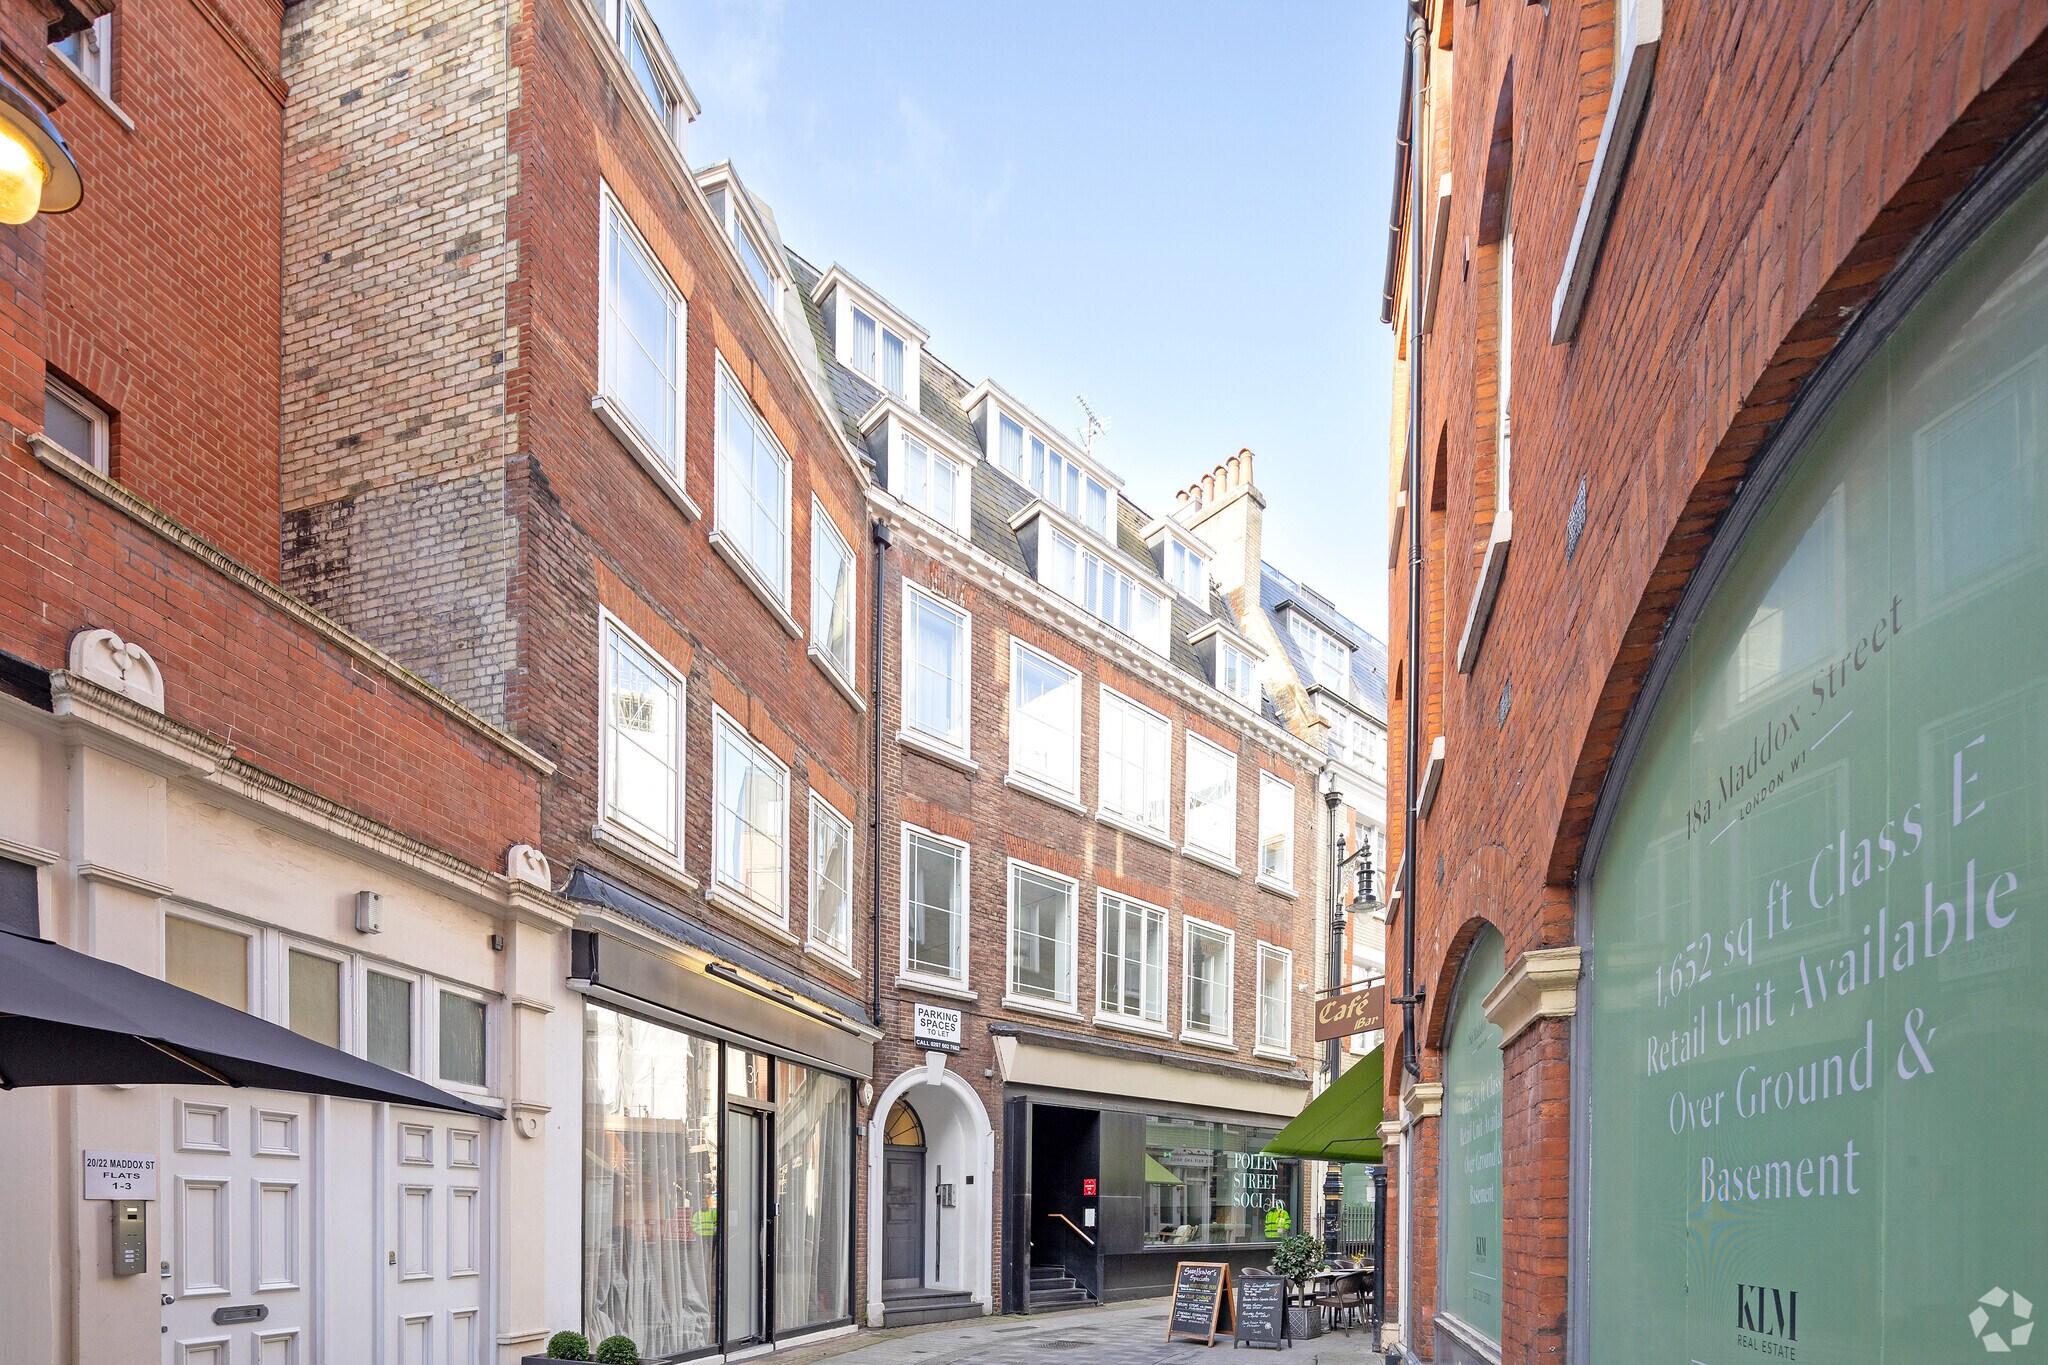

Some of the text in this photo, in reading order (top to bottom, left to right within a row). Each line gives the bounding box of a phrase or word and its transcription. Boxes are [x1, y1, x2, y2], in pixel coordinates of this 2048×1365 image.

[1686, 594, 1902, 840] 18a Maddox Street
[1740, 750, 1806, 821] LONDON W1
[1655, 733, 1986, 1010] 1,652 sq ft Class E
[1647, 858, 2018, 1077] Retail Unit Available
[918, 1008, 958, 1022] PARKING
[1319, 992, 1370, 1024] Café
[920, 1018, 956, 1032] SPACES
[928, 1028, 937, 1036] TO
[1354, 1016, 1379, 1030] Bar
[1669, 1007, 1937, 1135] Over Ground &
[87, 1158, 155, 1169] 20/22 MADDOX ST
[1701, 1139, 1860, 1203] Basement
[112, 1182, 132, 1190] 1-3
[1233, 1172, 1278, 1190] STREET
[1736, 1283, 1799, 1341] KLM
[1737, 1334, 1796, 1361] REAL ESTATE
